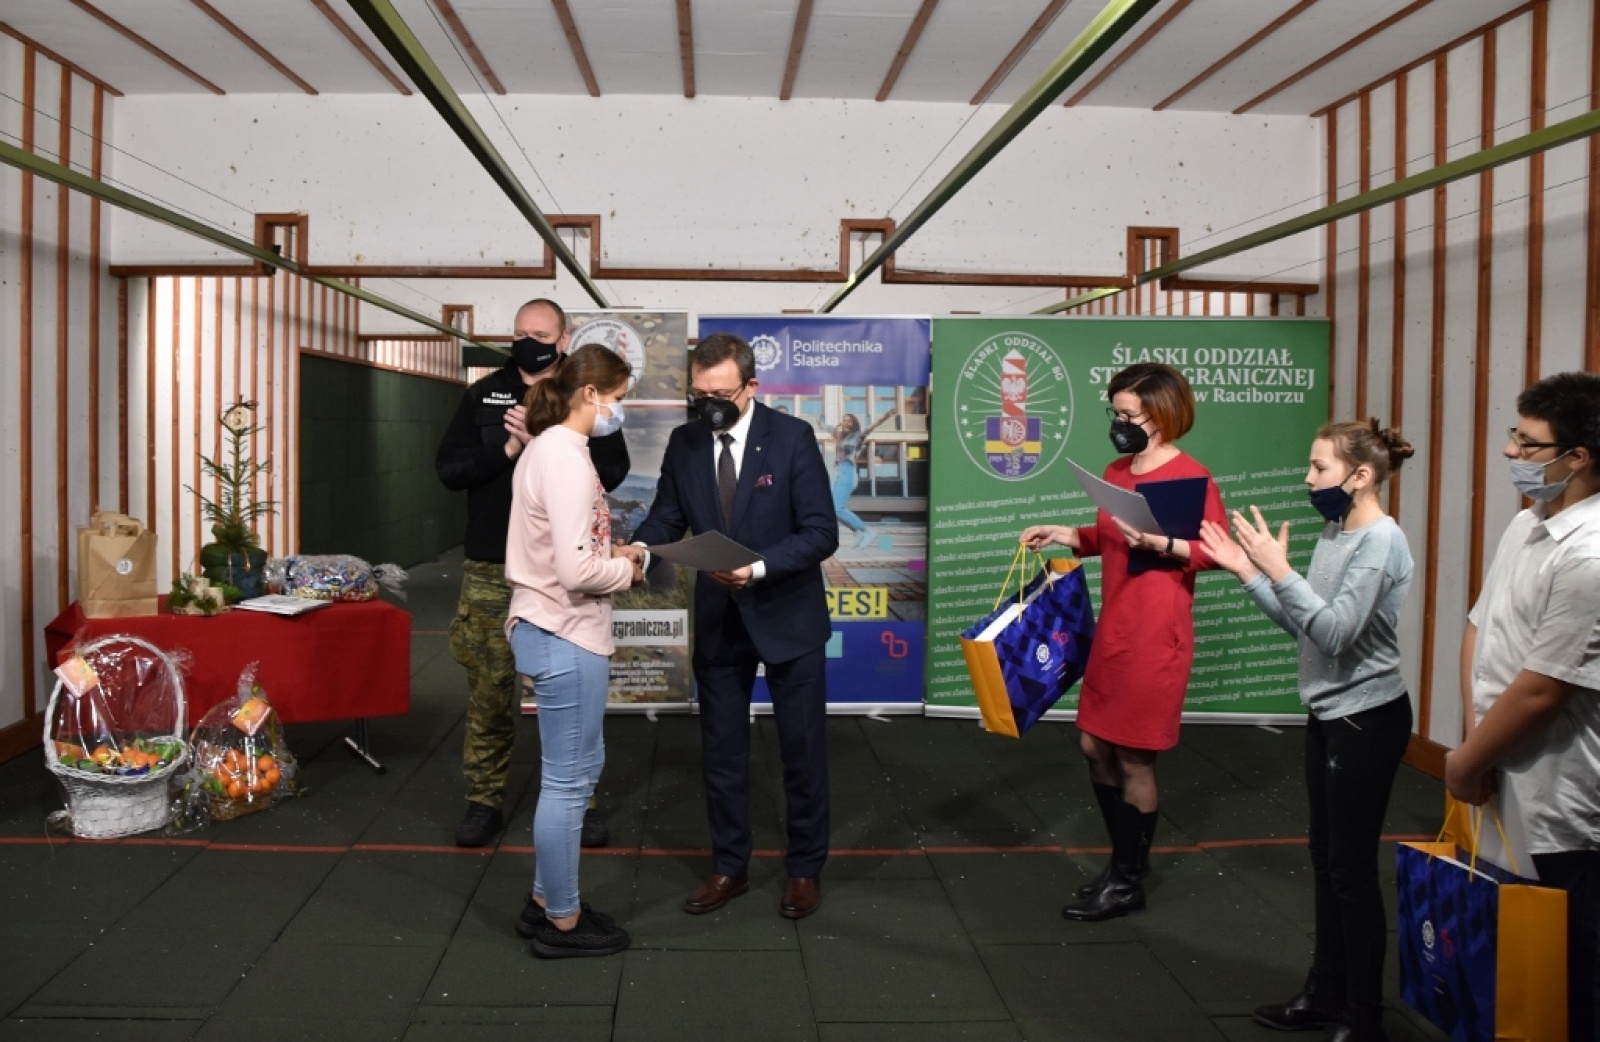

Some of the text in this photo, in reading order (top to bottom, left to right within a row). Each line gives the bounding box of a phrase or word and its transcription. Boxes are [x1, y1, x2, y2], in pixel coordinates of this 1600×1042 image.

[793, 339, 884, 353] Politechnika
[793, 351, 840, 369] Śląska
[1194, 347, 1293, 367] ODDZIAŁ
[1182, 367, 1315, 390] GRANICZNEJ
[1213, 388, 1304, 404] Raciborzu
[613, 617, 684, 640] zgraniczna.pl
